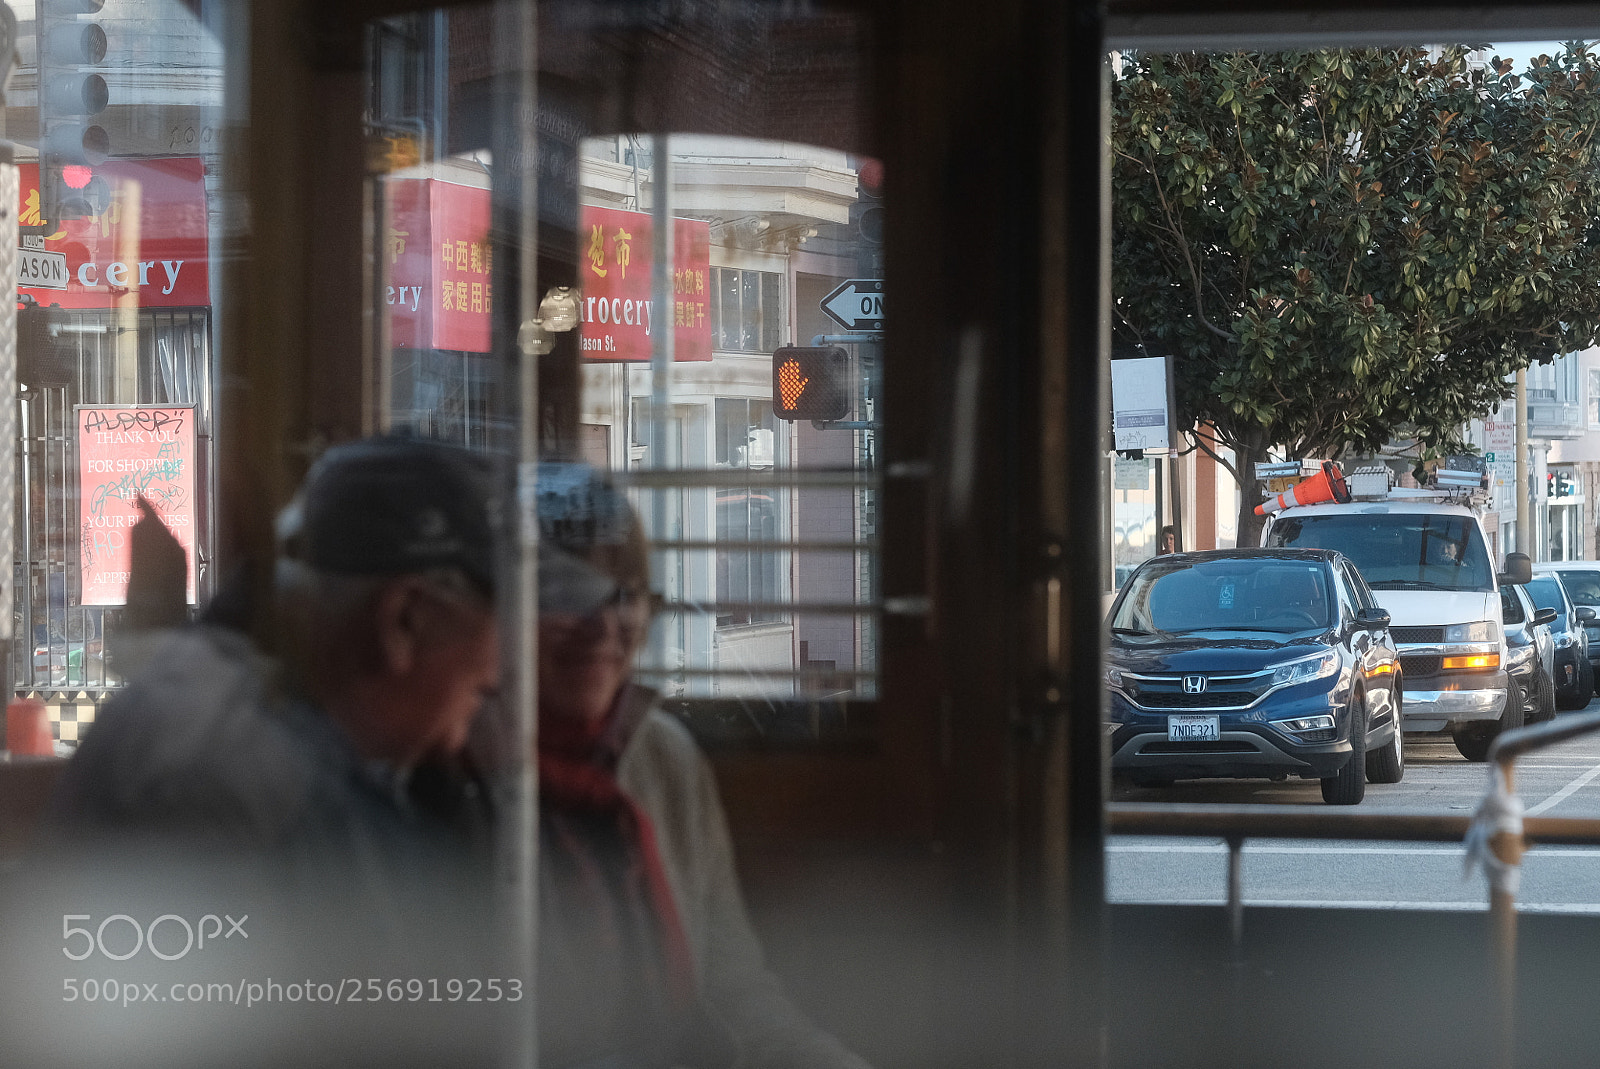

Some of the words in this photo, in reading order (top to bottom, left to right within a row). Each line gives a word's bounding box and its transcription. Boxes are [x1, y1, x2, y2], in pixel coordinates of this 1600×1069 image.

[65, 260, 184, 295] cery
[580, 296, 654, 335] rocery
[605, 335, 616, 352] St.
[95, 431, 145, 443] THANK
[147, 430, 176, 443] YOU
[87, 460, 114, 473] FOR
[117, 458, 185, 472] SHOPPING
[120, 488, 156, 500] HERE
[86, 515, 125, 528] YOUR
[1172, 724, 1214, 737] 7NDE321
